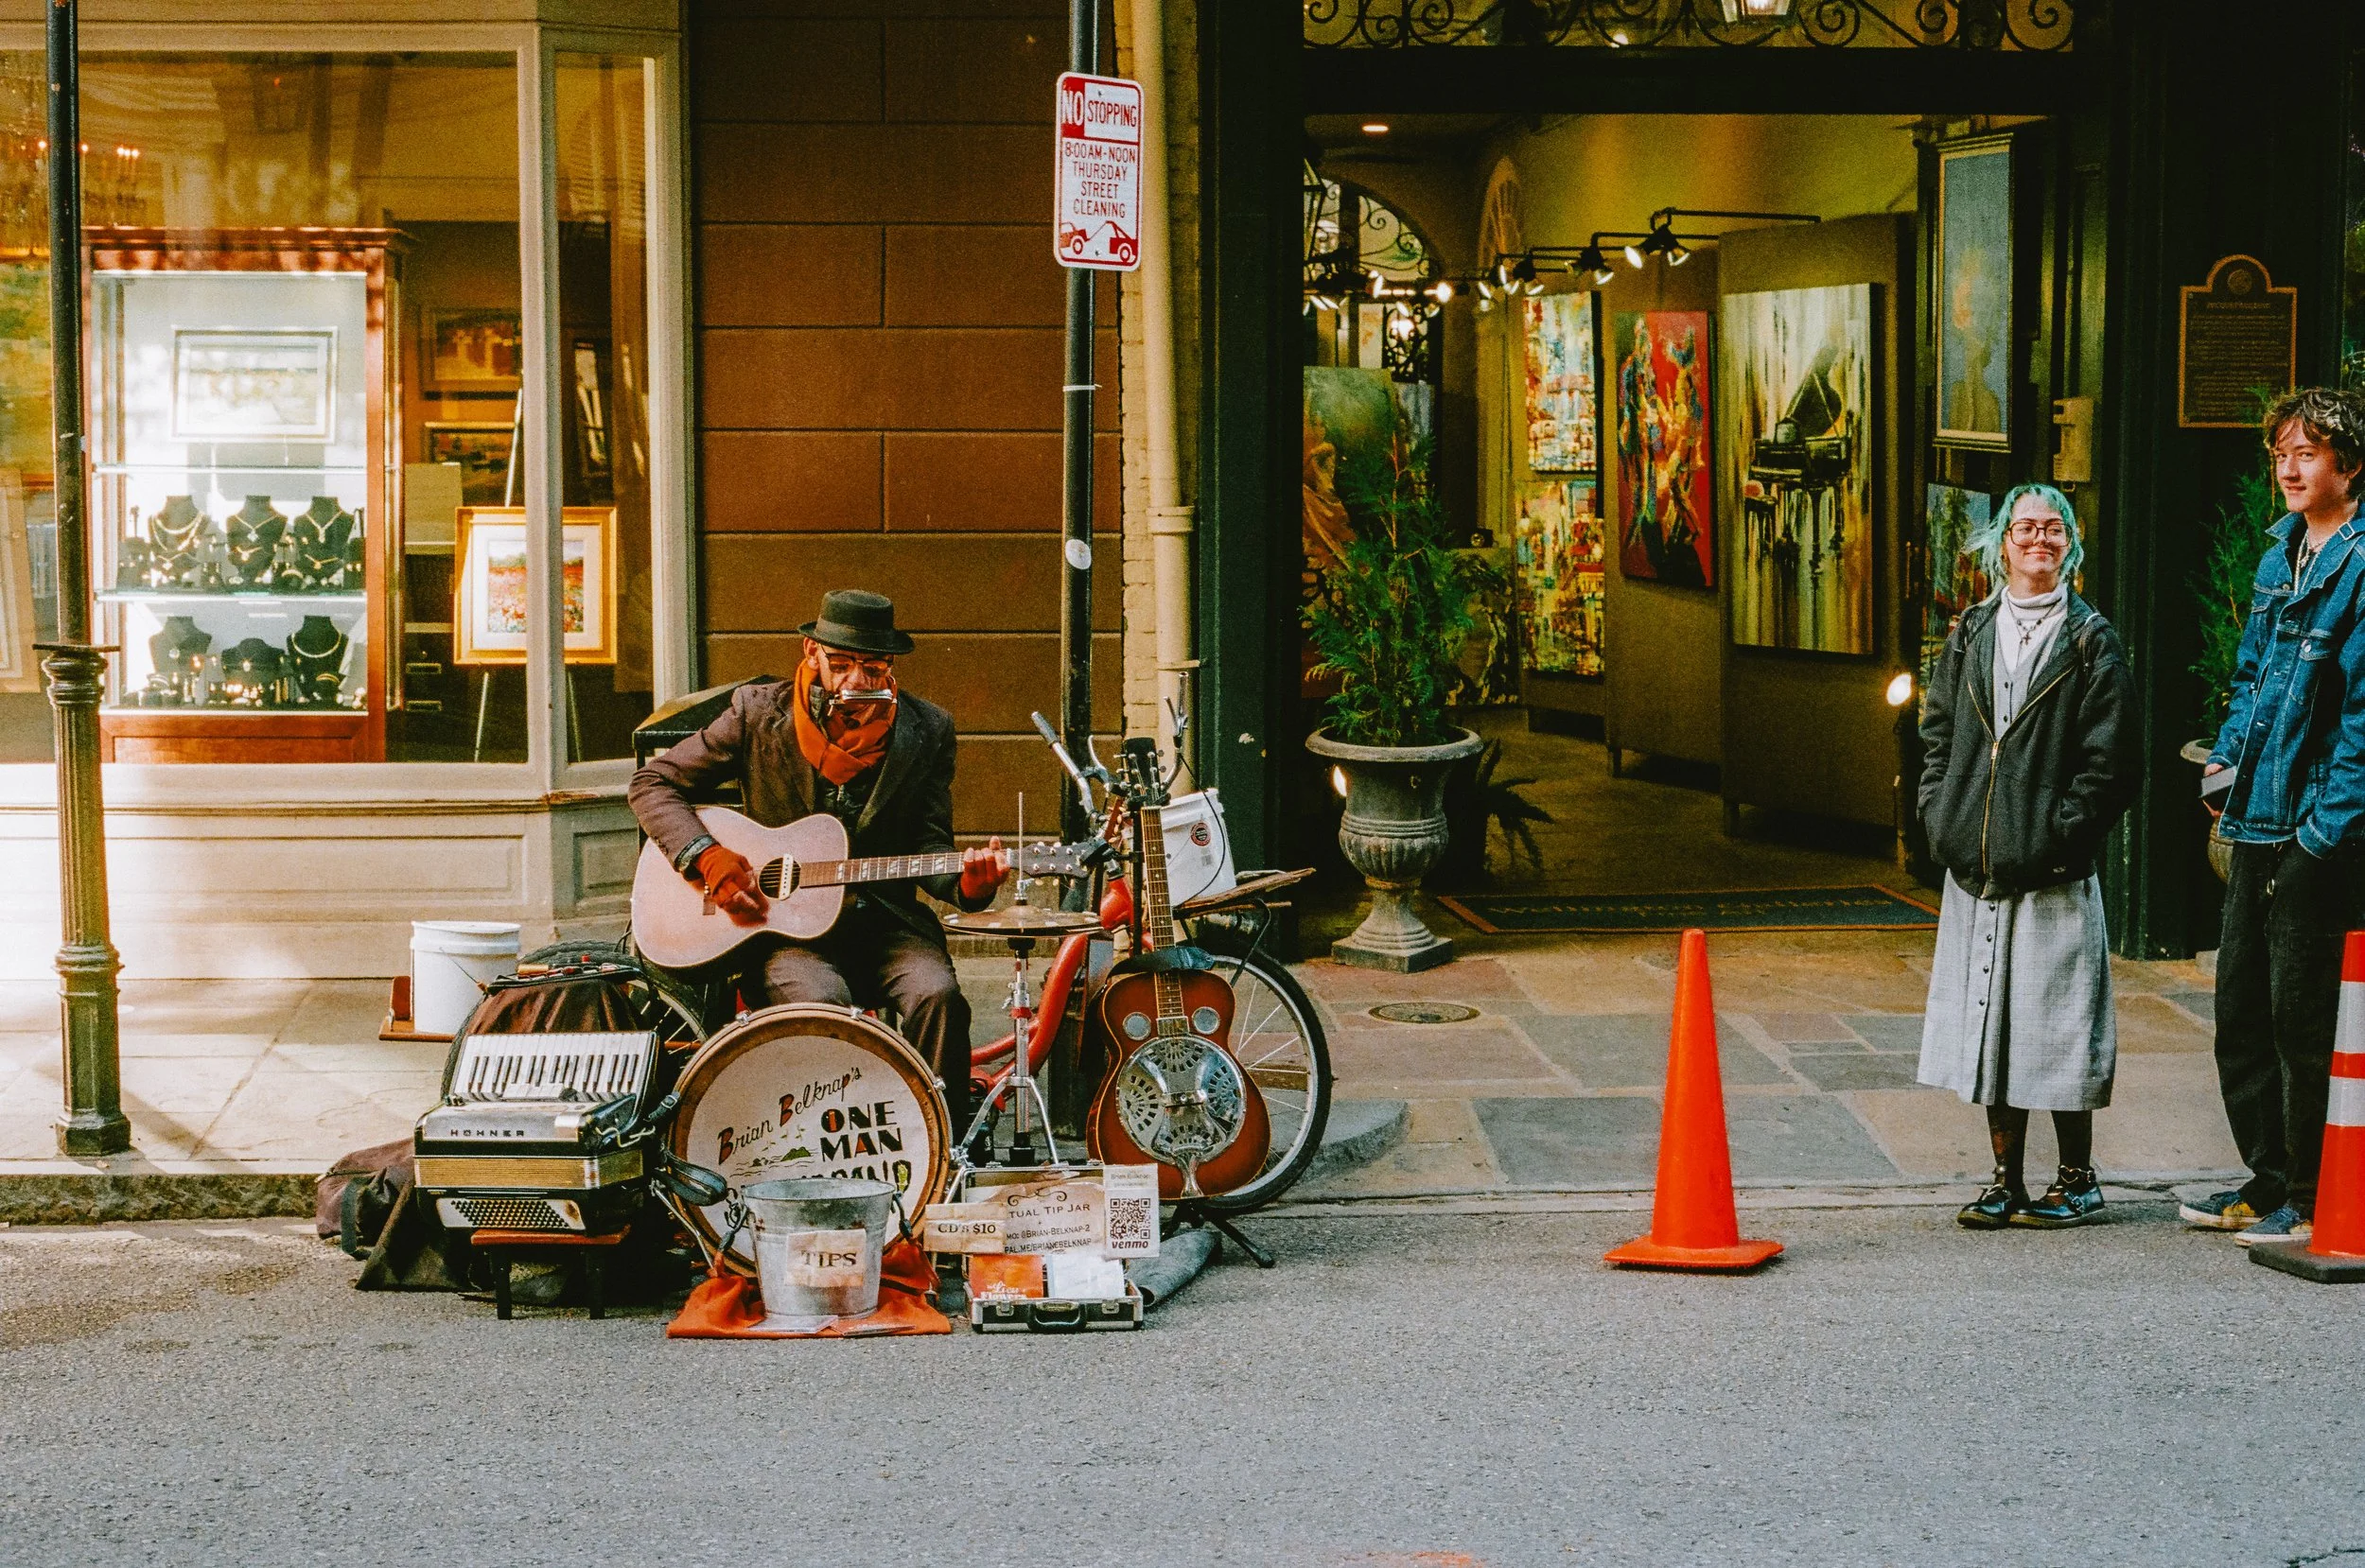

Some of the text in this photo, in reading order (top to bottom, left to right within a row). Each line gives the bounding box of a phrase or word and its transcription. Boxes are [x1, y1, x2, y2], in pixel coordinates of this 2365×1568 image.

[1061, 90, 1137, 128] NO STOPPING
[1072, 161, 1128, 182] THURSDAY
[1080, 181, 1119, 200] STREET
[1073, 199, 1126, 218] CLEANING
[716, 1066, 863, 1165] Brian Belknap's
[820, 1100, 898, 1134] ONE
[450, 1128, 525, 1138] HOHNER
[819, 1126, 903, 1163] MAN
[1043, 1206, 1064, 1214] TIP
[1067, 1203, 1091, 1212] JAR
[972, 1223, 996, 1235] $10
[1112, 1241, 1149, 1249] venmo
[800, 1249, 858, 1269] TIPS
